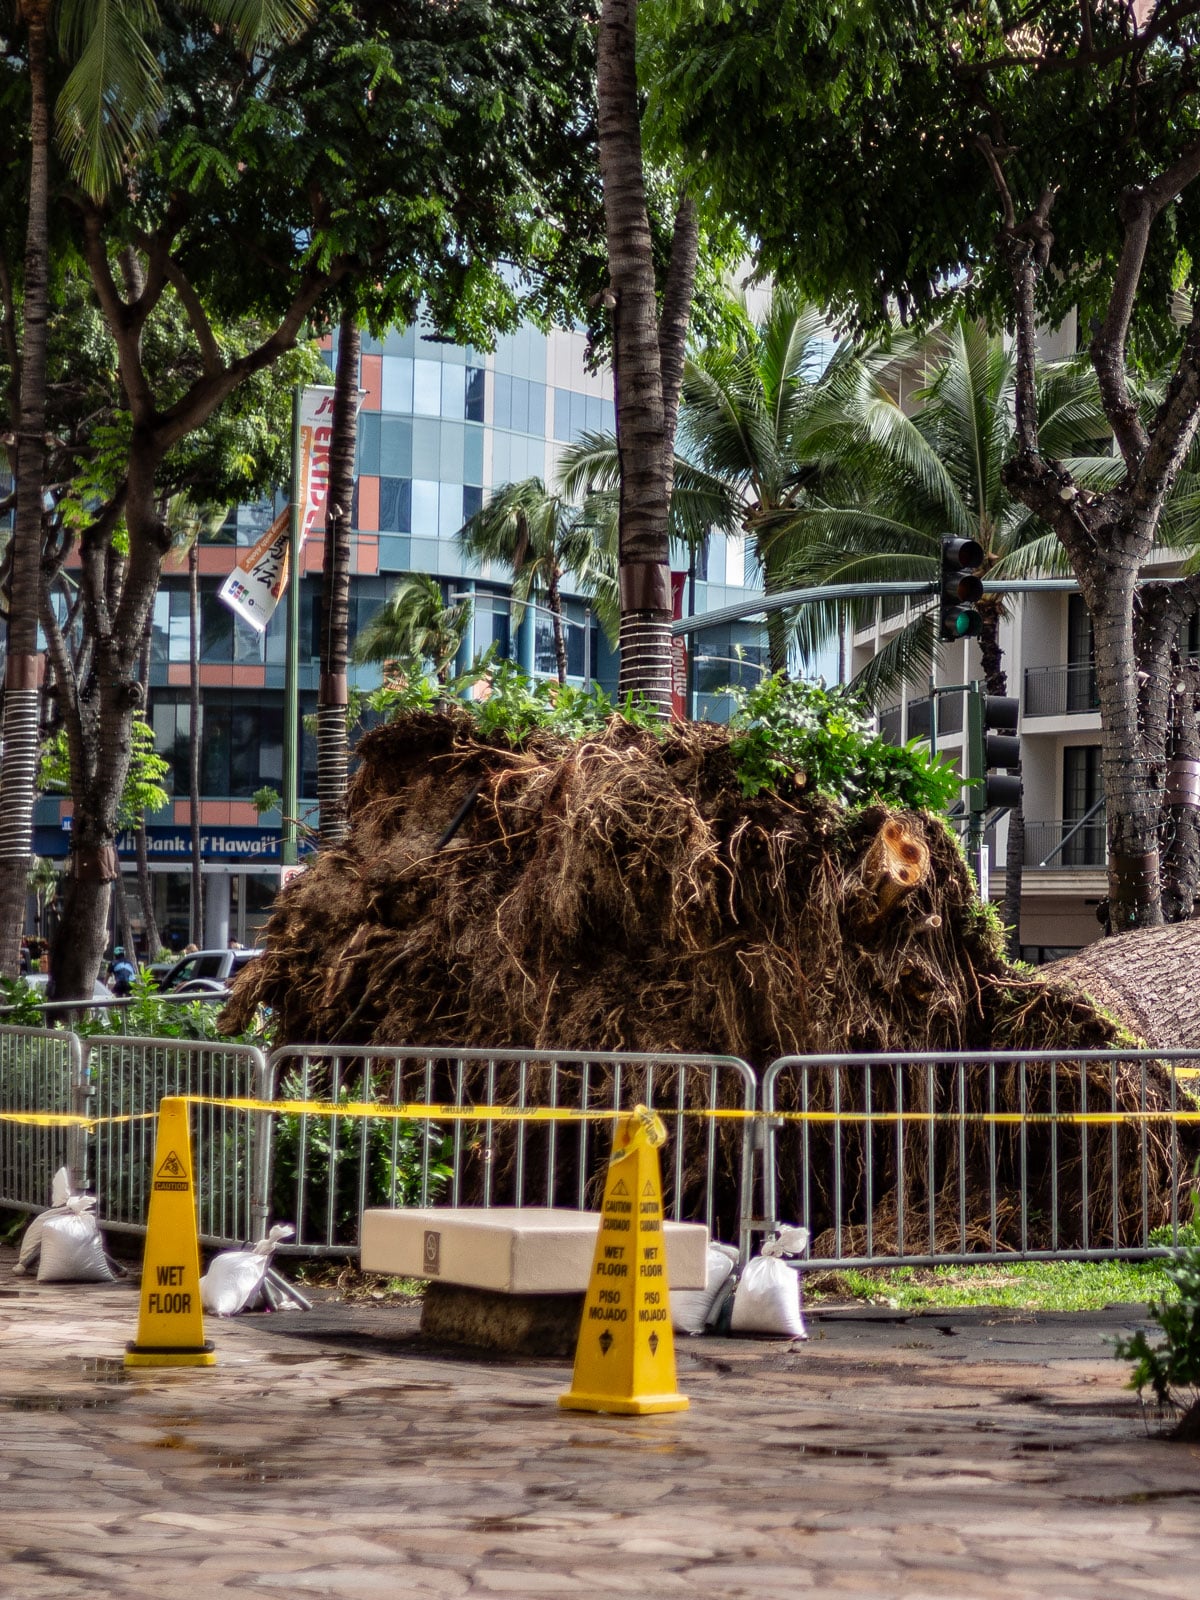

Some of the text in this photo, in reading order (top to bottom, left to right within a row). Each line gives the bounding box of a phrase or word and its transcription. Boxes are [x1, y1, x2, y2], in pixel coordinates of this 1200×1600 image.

[671, 637, 687, 697] ONOLULU
[145, 836, 185, 852] Bank
[155, 1182, 188, 1191] CAUTION
[605, 1201, 632, 1213] CAUTION
[639, 1202, 659, 1214] CAUTION
[602, 1218, 631, 1231] CUIDADO
[604, 1246, 625, 1259] WET
[643, 1248, 658, 1260] WET
[156, 1266, 185, 1286] WET
[596, 1263, 628, 1277] FLOOR
[640, 1265, 662, 1277] FLOOR
[148, 1293, 191, 1314] FLOOR
[598, 1290, 621, 1304] PISO
[644, 1292, 660, 1304] PISO
[588, 1307, 628, 1322] MOJADO
[638, 1309, 667, 1322] MOJADO
